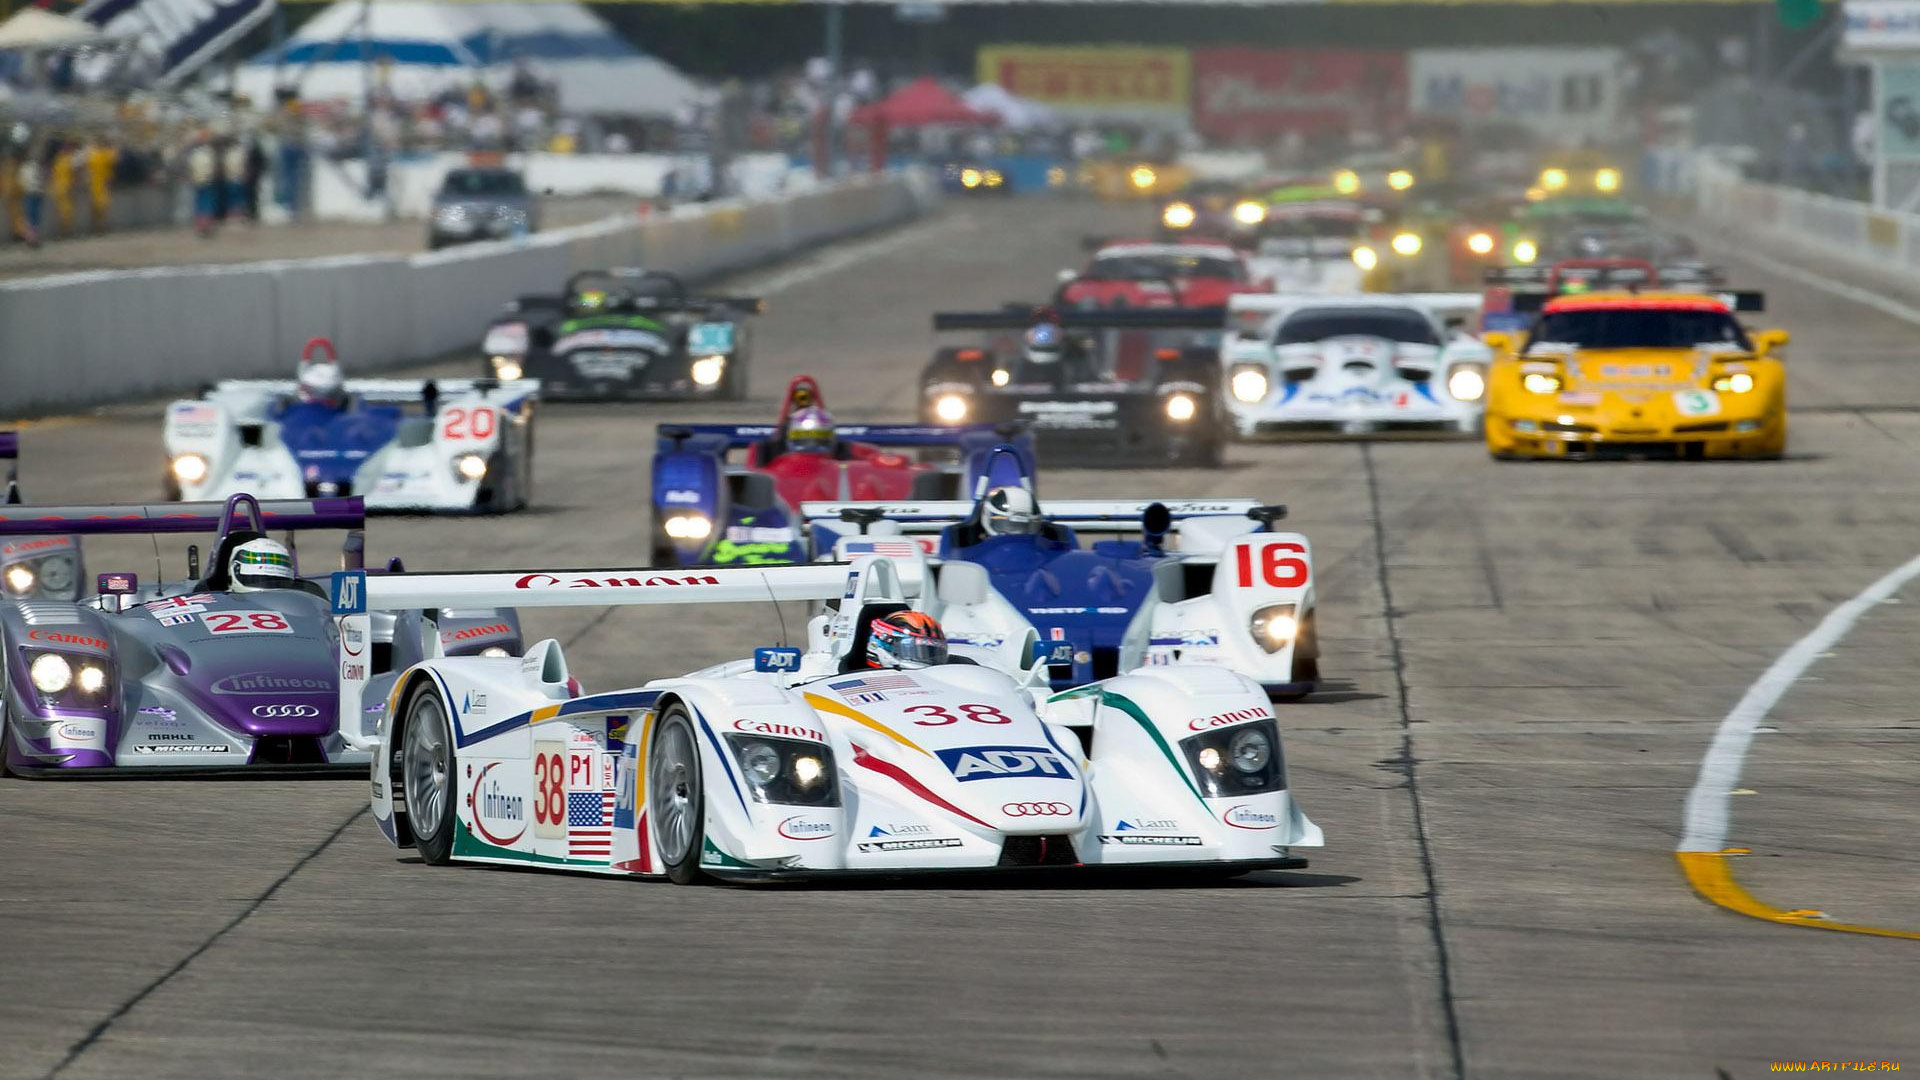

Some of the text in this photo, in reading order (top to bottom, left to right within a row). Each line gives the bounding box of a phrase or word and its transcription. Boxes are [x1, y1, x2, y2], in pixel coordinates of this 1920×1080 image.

[445, 408, 495, 439] 20
[1236, 542, 1309, 588] 16
[514, 573, 720, 589] Canon
[337, 576, 360, 610] ADT
[206, 613, 290, 633] 28
[440, 622, 512, 644] Canon
[28, 629, 108, 650] Canon
[769, 651, 797, 668] ADT
[342, 660, 364, 681] Canon
[231, 672, 332, 691] Infineon
[903, 703, 1013, 726] 38
[1188, 707, 1269, 732] Canon
[64, 724, 96, 737] Infineon
[733, 718, 824, 742] Canon
[571, 755, 591, 786] P1
[953, 751, 1059, 776] ADT
[534, 752, 565, 826] 38
[483, 779, 523, 821] Infineon
[788, 817, 832, 833] Infineon
[1136, 818, 1176, 828] Lam
[1234, 808, 1276, 824] Infineon
[889, 823, 929, 834] Lam
[882, 839, 963, 849] MICHELIN
[1121, 836, 1201, 846] MICHELIN
